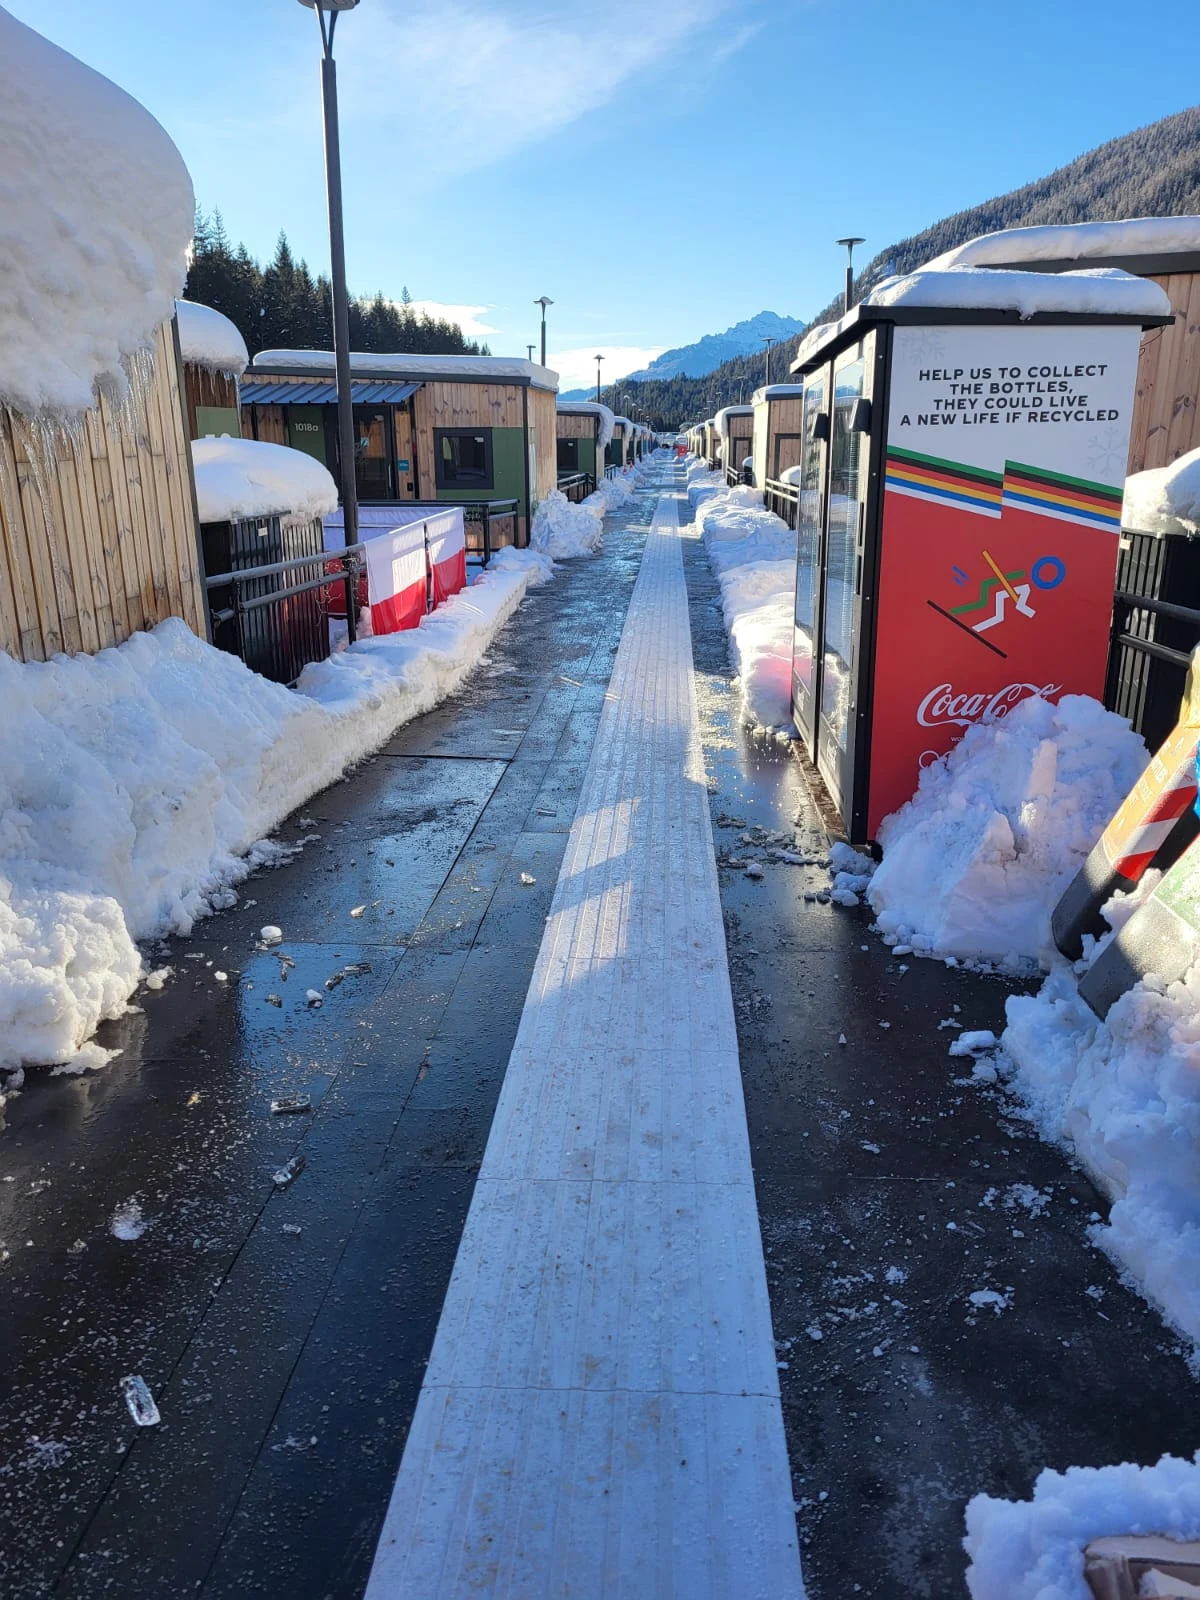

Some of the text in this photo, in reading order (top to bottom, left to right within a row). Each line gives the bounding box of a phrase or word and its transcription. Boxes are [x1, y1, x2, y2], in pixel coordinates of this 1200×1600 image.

[919, 365, 1107, 381] HELP US TO COLLECT
[950, 381, 1072, 395] THE BOTTLES,
[934, 396, 1088, 410] THEY COULD LIVE
[900, 410, 1118, 426] A NEW LIFE IF RECYCLED
